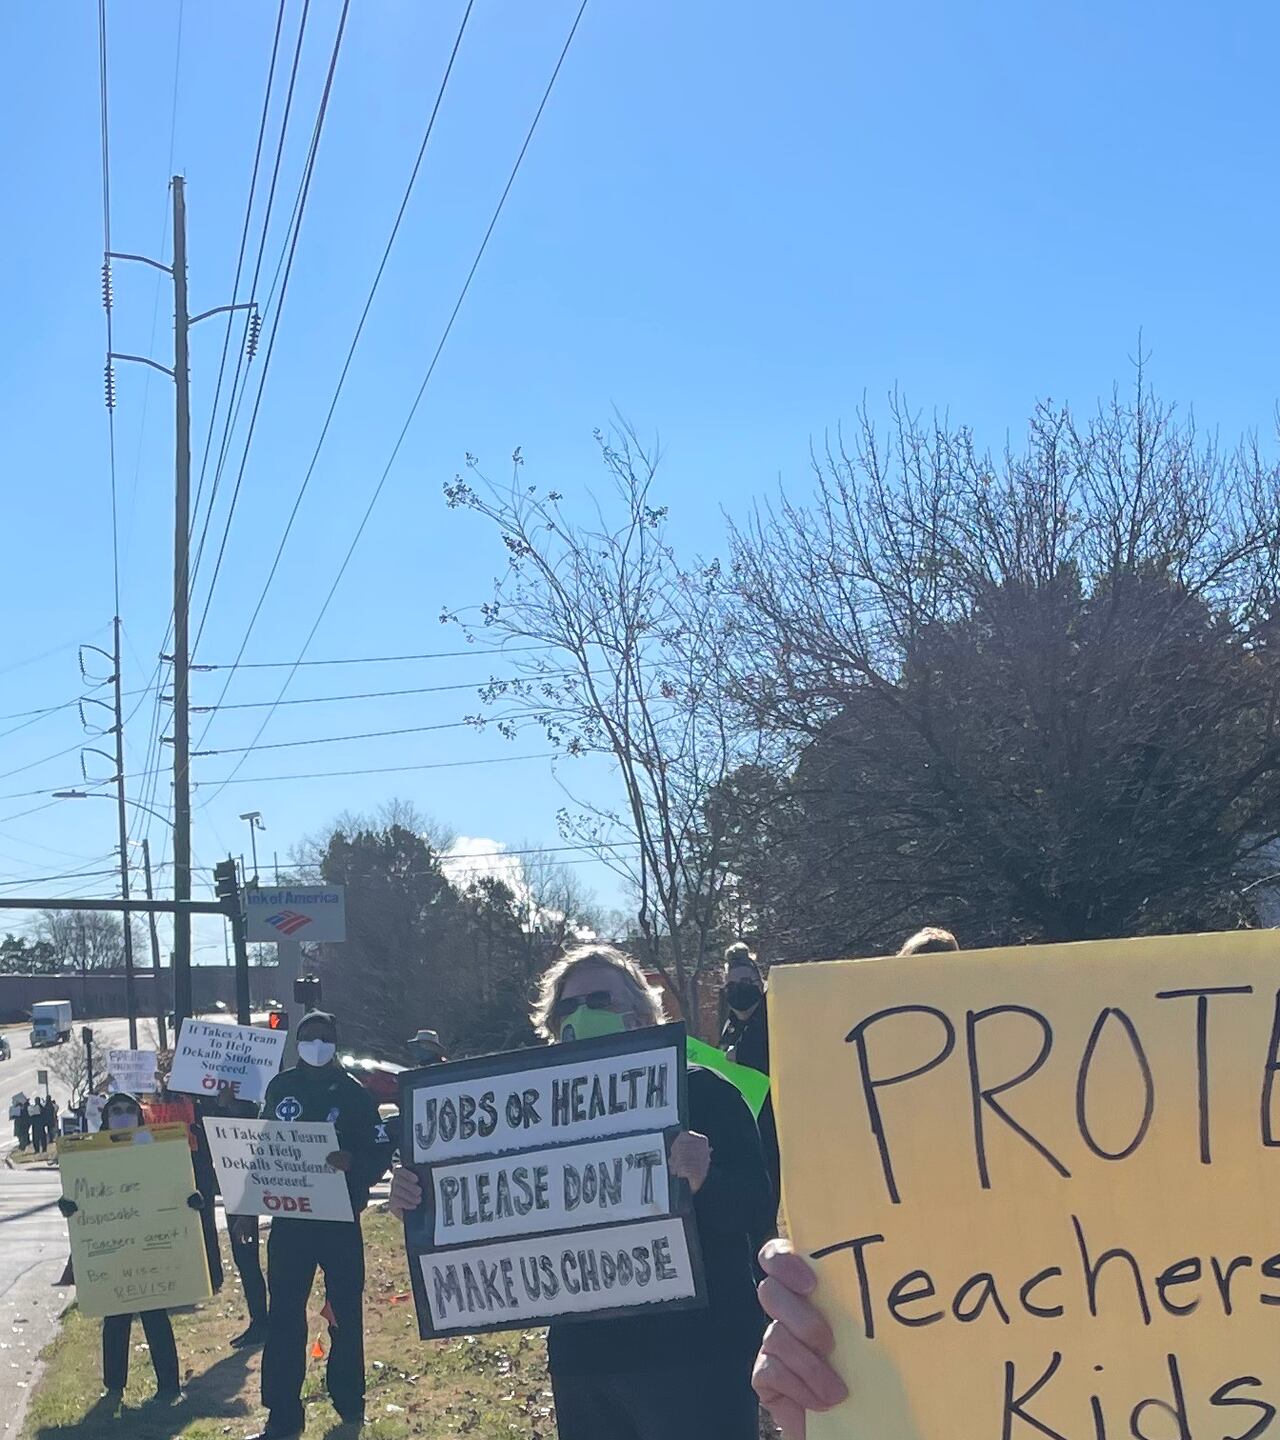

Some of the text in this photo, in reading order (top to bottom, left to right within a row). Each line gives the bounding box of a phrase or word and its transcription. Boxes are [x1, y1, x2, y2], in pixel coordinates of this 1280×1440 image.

[285, 890, 339, 904] America
[188, 1024, 277, 1045] It Takes A Team
[209, 1038, 252, 1053] To Help
[224, 1053, 273, 1067] Students
[415, 1063, 668, 1150] JOBS OR HEALTH
[215, 1127, 328, 1144] It Takes A Team
[246, 1143, 301, 1160] To Help
[439, 1149, 663, 1228] PLEASE DON'T
[263, 1192, 312, 1212] ODE
[432, 1236, 679, 1320] MAKE US CHOOSE
[114, 1281, 177, 1298] REVISE
